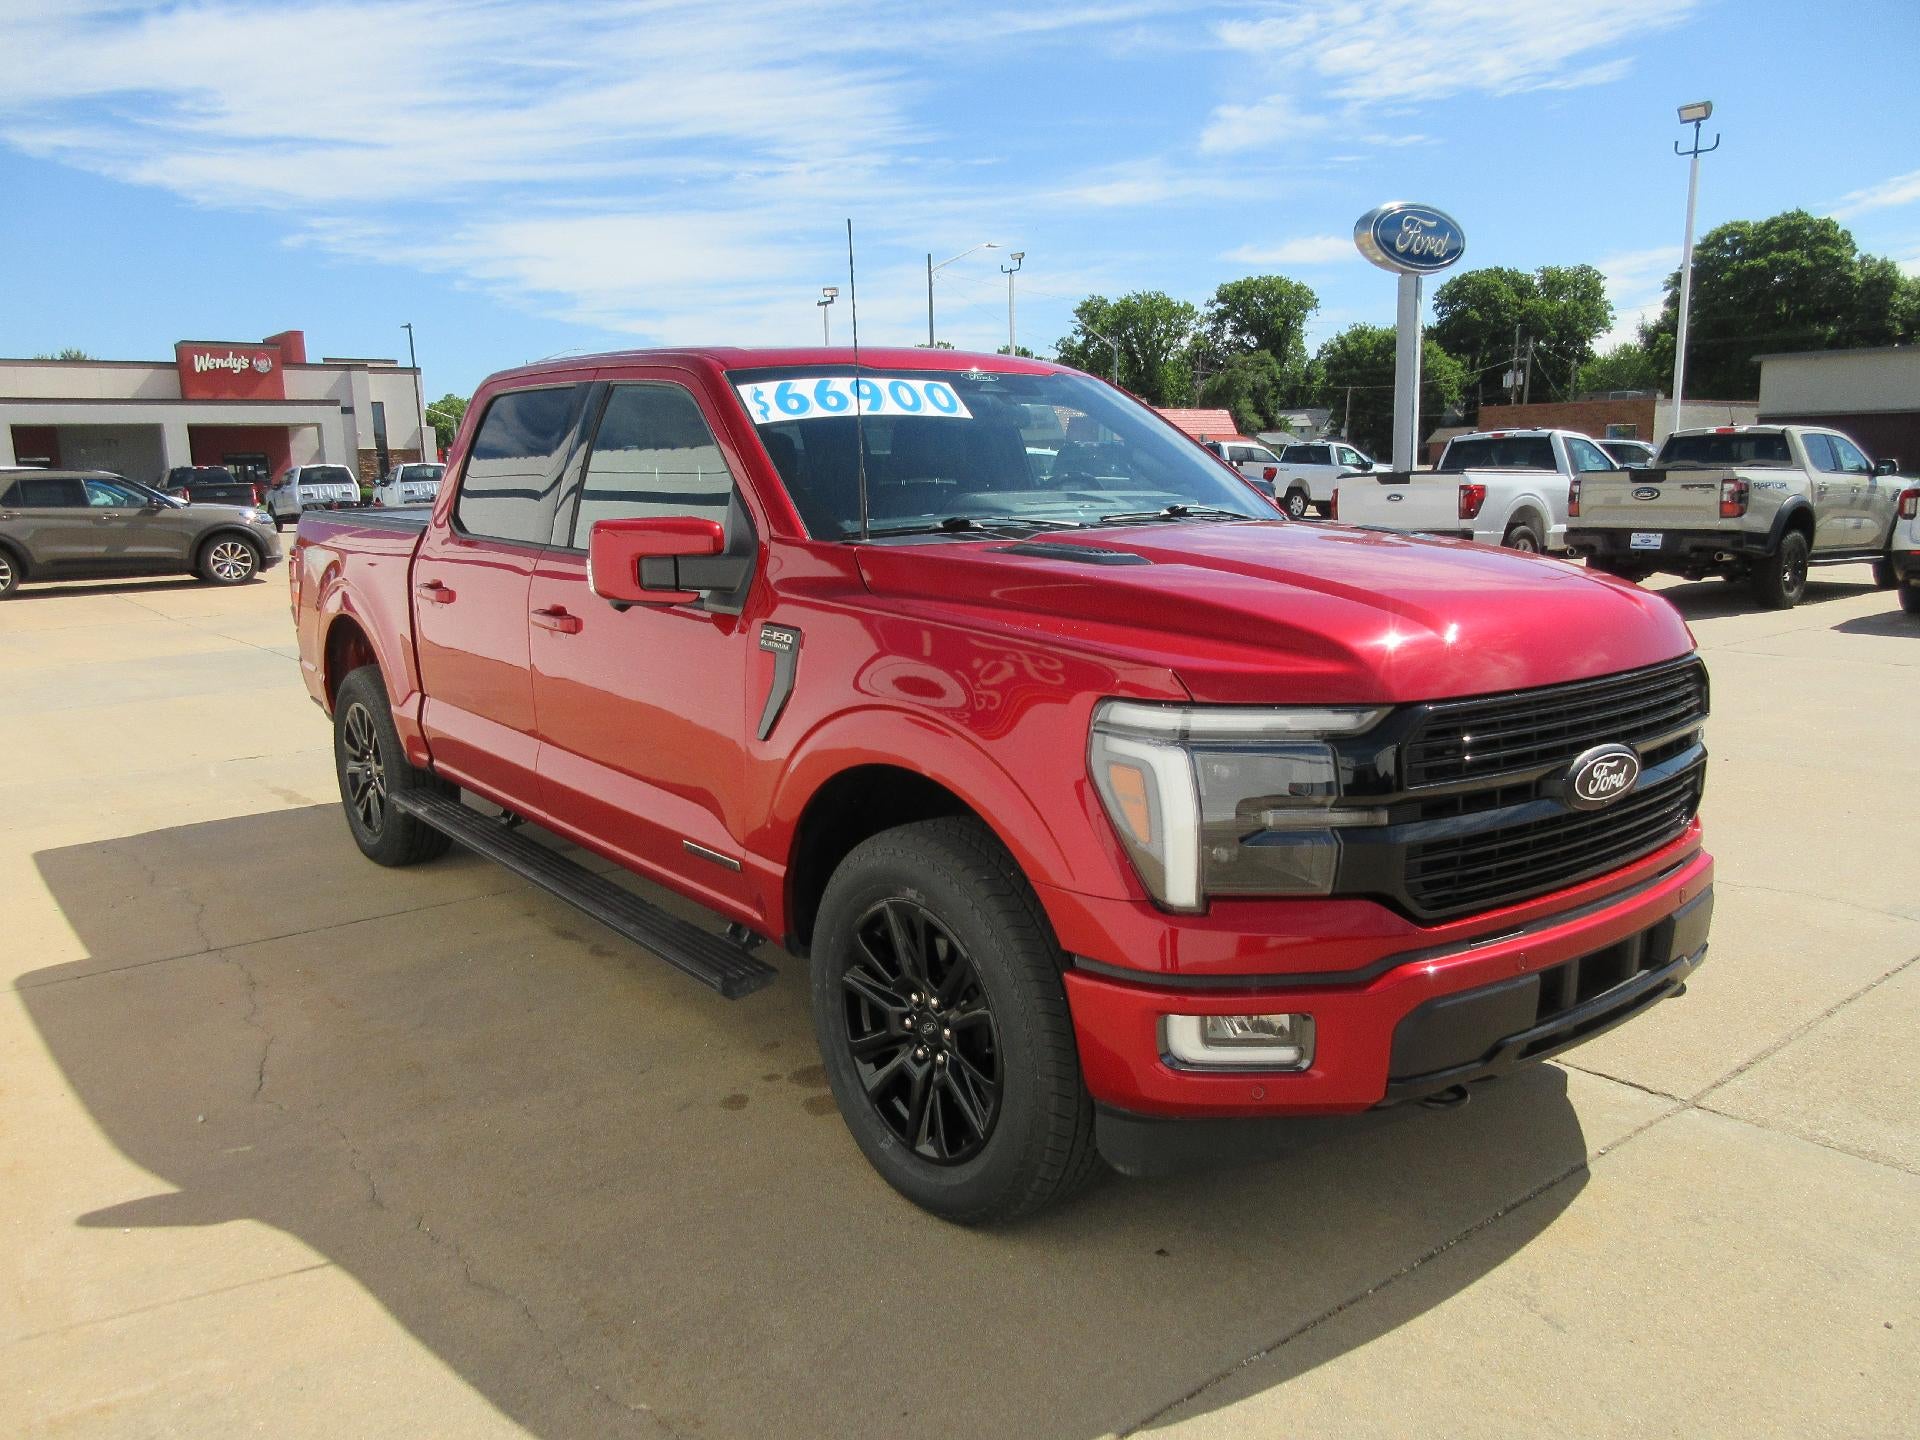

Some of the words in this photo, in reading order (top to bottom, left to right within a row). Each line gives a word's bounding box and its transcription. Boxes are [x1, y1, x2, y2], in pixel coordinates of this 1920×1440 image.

[1395, 215, 1450, 257] Ford
[193, 351, 250, 374] Wendy's
[750, 377, 961, 422] $66900
[1752, 481, 1788, 490] RAPTOR
[760, 629, 794, 644] F-150
[760, 639, 790, 651] PLATINUM
[1587, 759, 1628, 795] Ford
